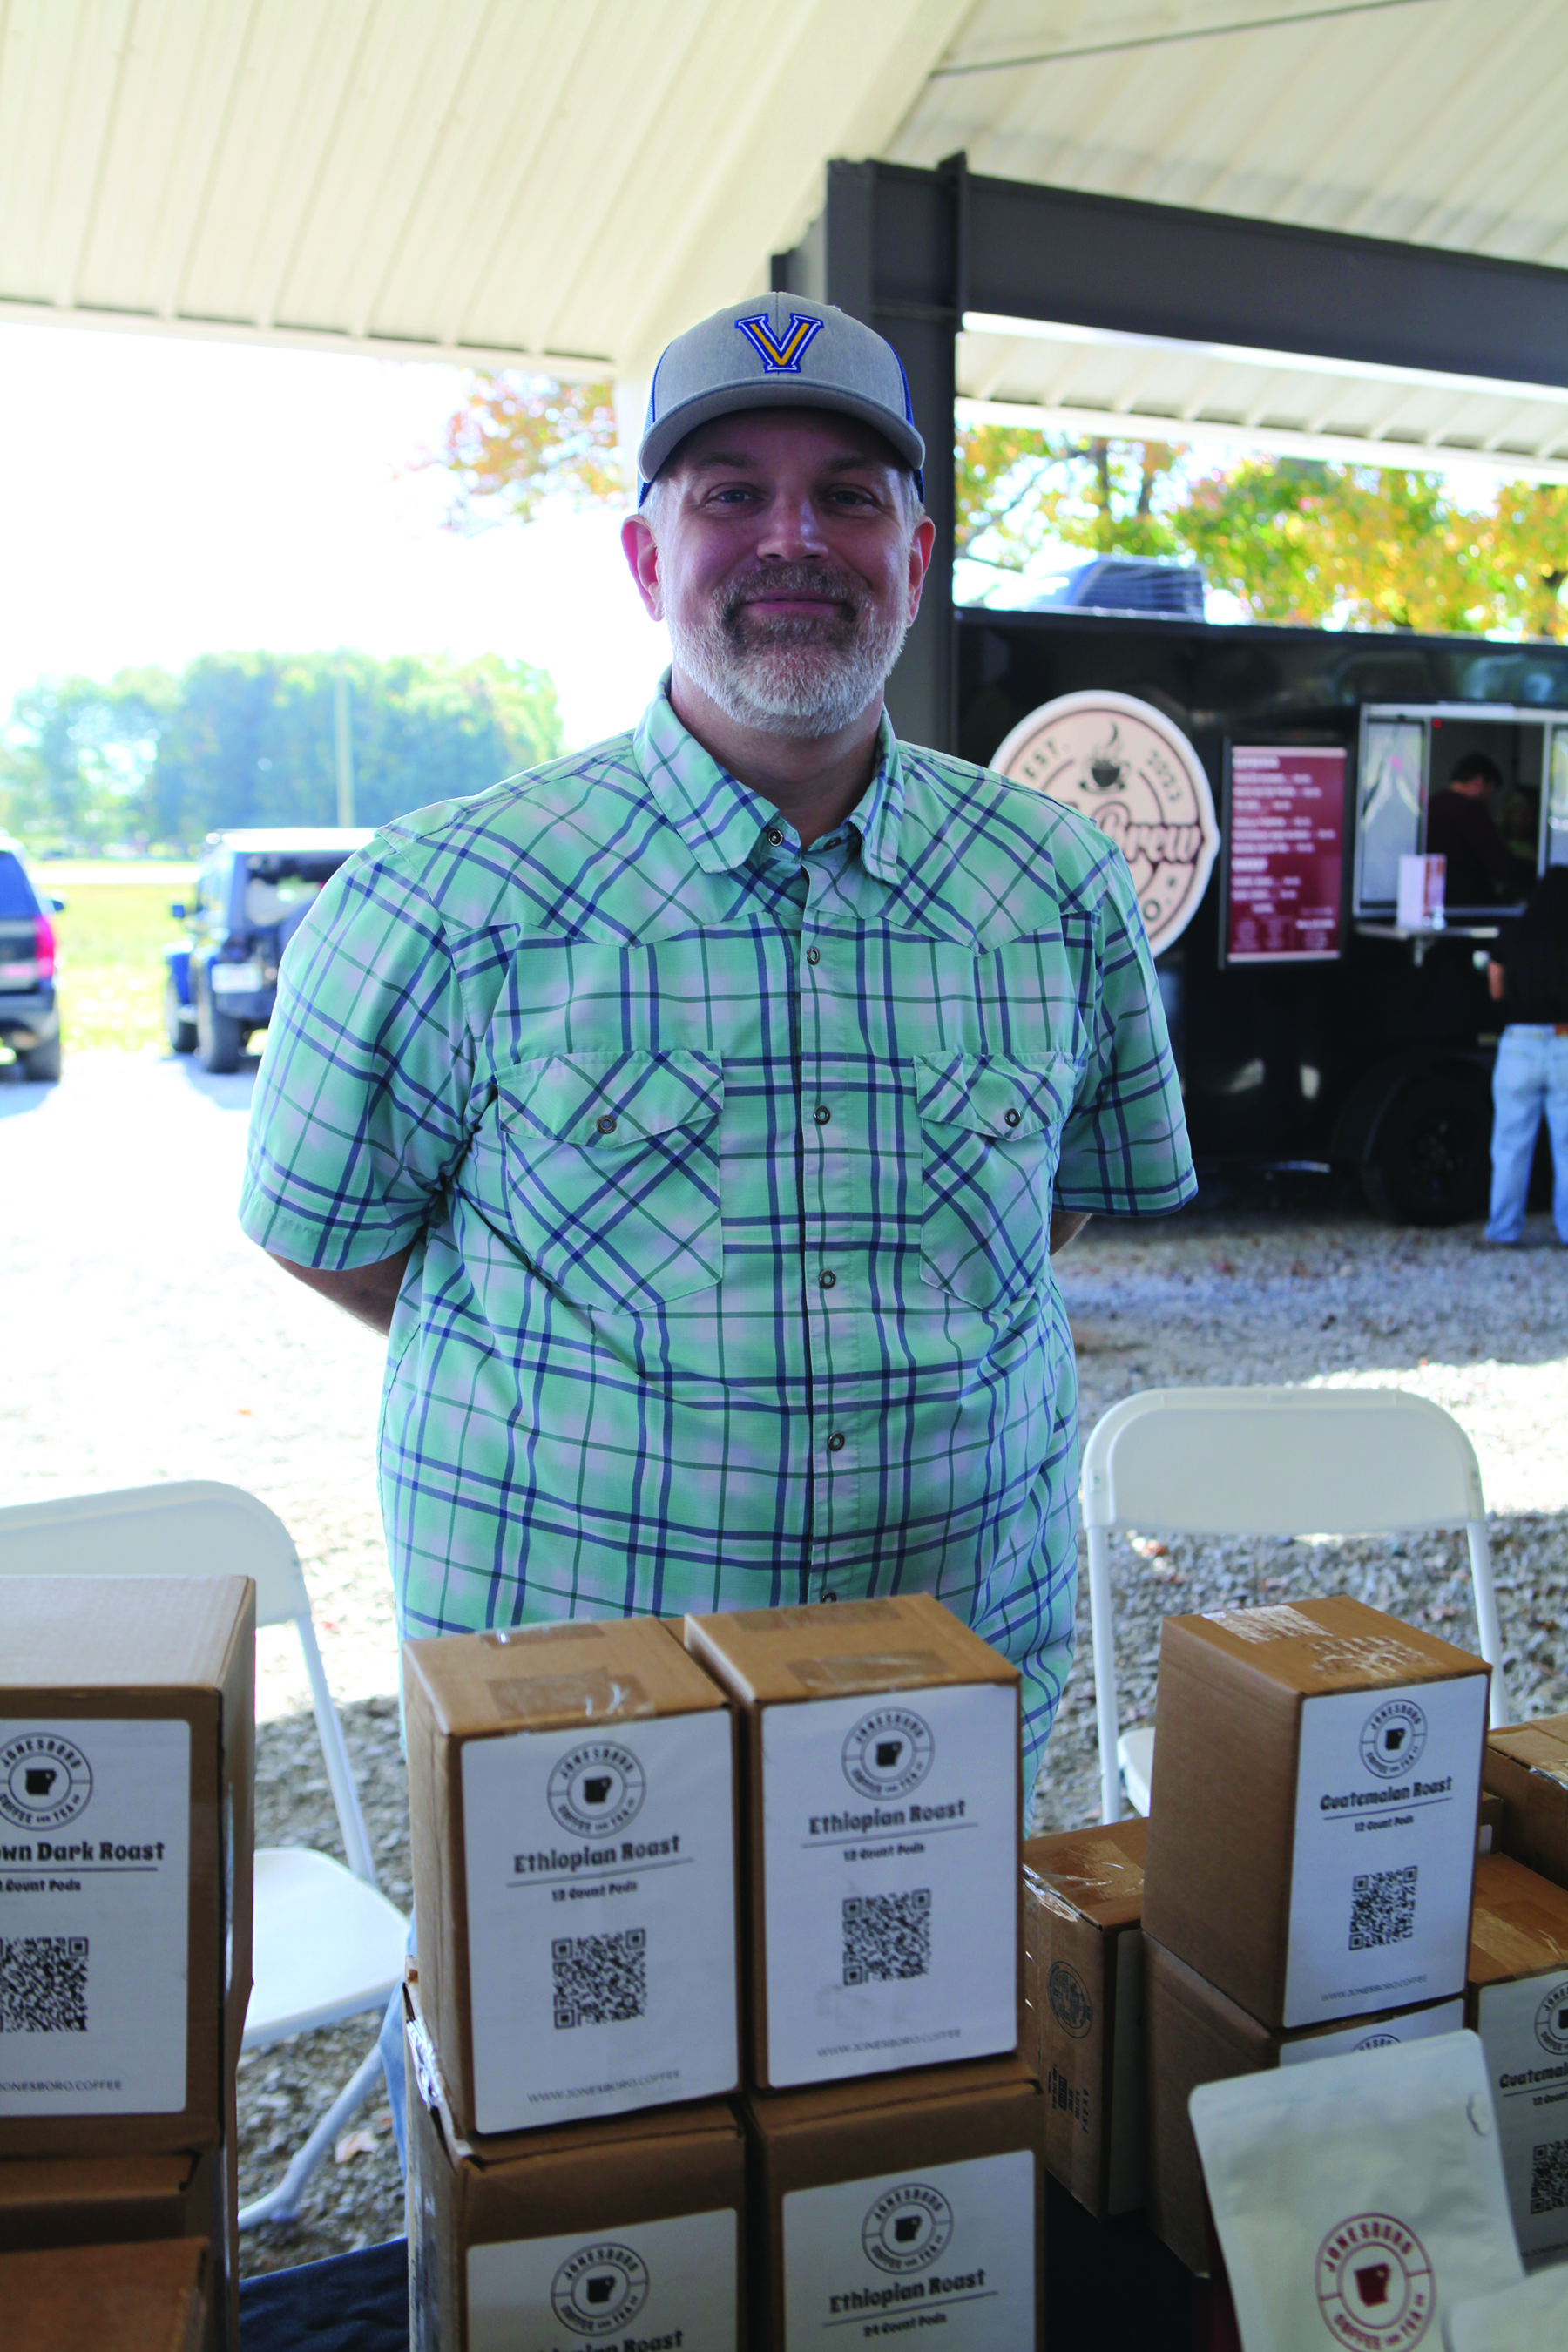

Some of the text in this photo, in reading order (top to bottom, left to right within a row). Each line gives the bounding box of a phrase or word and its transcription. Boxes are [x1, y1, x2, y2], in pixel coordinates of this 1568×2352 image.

[735, 313, 823, 373] V
[1320, 1775, 1452, 1811] Guatemalan Roast
[809, 1799, 965, 1835] Ethiopian Roast
[0, 1841, 166, 1861] wn Dark Roast
[514, 1835, 679, 1873] Ethiopian Roast
[860, 1846, 894, 1860] Count
[897, 1842, 925, 1856] Pods
[6, 1877, 45, 1892] Count
[49, 1877, 81, 1891] Pods
[569, 1884, 605, 1898] Count
[609, 1880, 638, 1895] Pods
[0, 2080, 121, 2092] ONESBORO.COFFEE
[829, 2268, 985, 2313] Ethiopian Roast
[882, 2318, 916, 2334] Count
